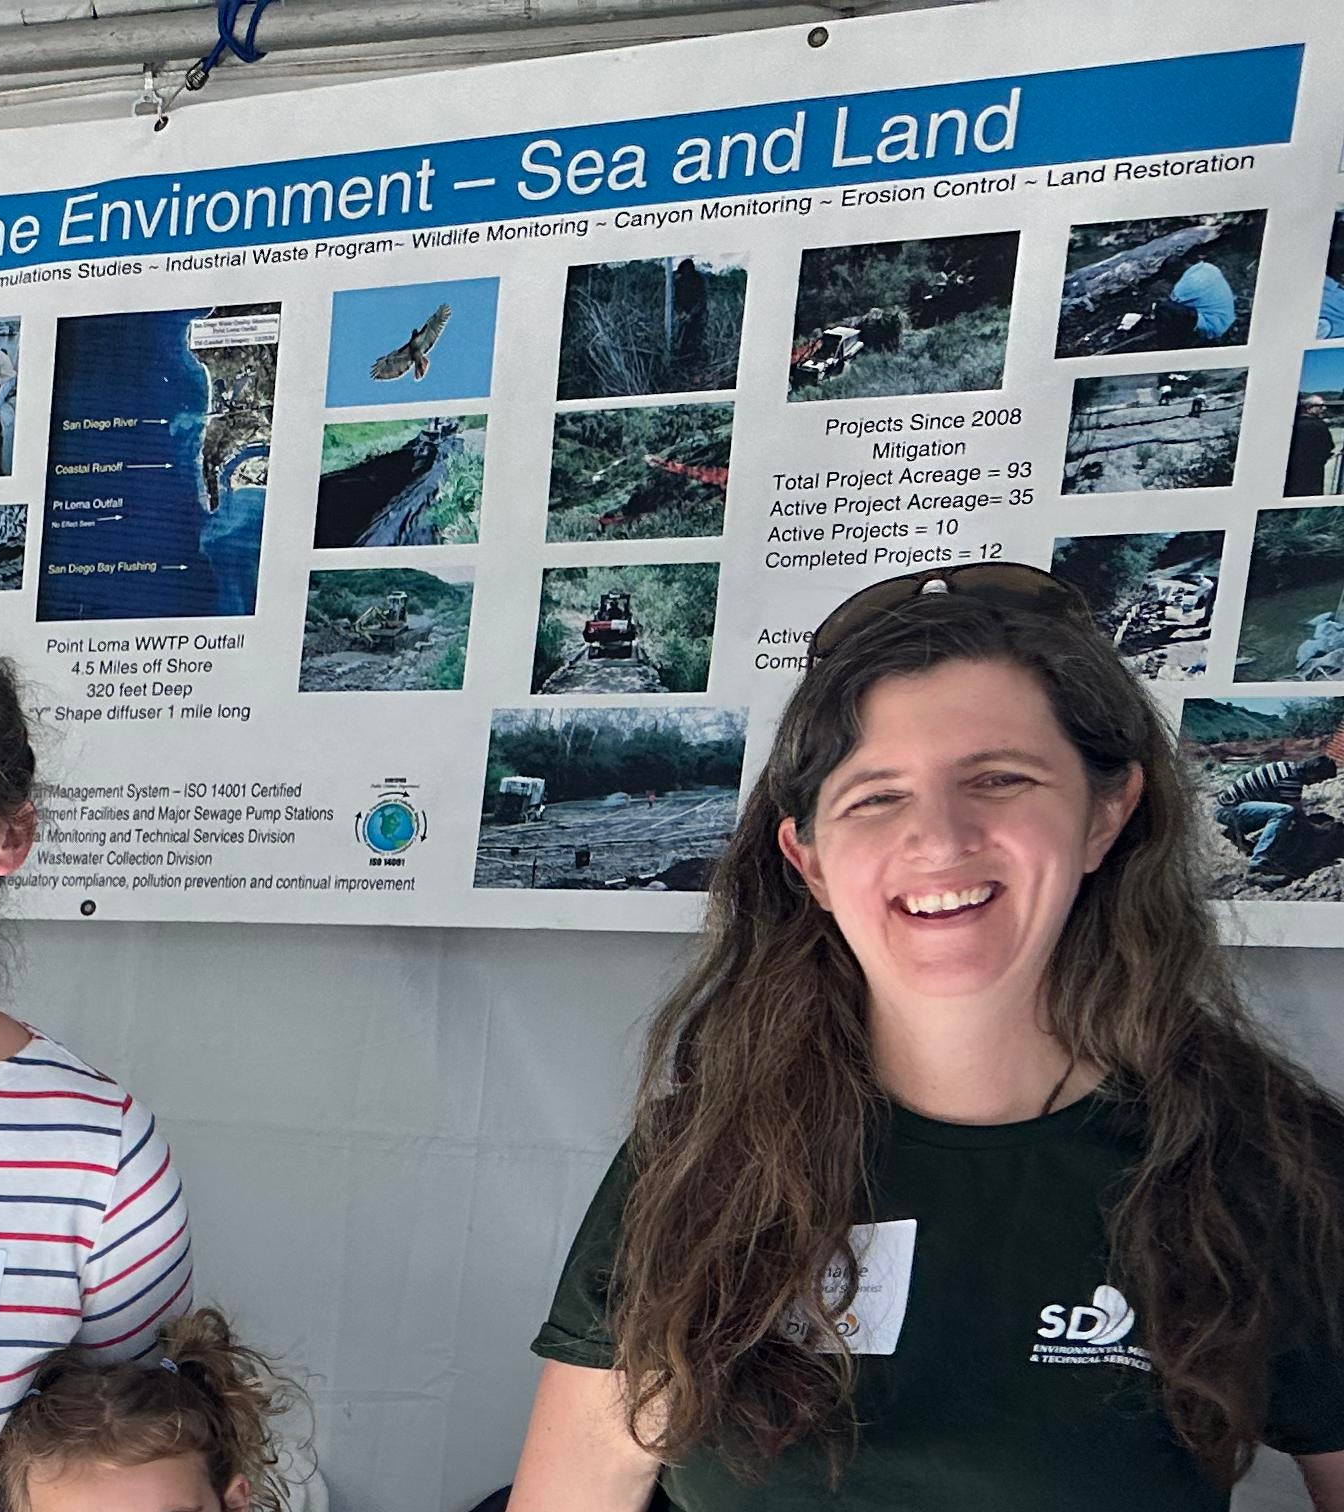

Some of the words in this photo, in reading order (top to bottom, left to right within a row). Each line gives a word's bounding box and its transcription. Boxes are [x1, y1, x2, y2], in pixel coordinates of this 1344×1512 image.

[59, 158, 435, 248] Environment
[518, 139, 646, 201] Sea
[673, 111, 805, 182] and
[832, 88, 1021, 168] Land
[78, 260, 142, 281] Studies
[165, 250, 247, 273] Industrial
[253, 245, 309, 265] Waste
[412, 226, 480, 249] Wildlife
[487, 217, 588, 244] Monitoring
[614, 206, 694, 231] Canyon
[701, 196, 812, 222] Monitoring
[841, 184, 925, 208] Erosion
[933, 174, 1016, 199] Control
[1047, 165, 1105, 188] Land
[1114, 152, 1255, 181] Restoration
[63, 421, 80, 431] San
[84, 419, 111, 431] Diego
[113, 417, 138, 428] River
[825, 416, 903, 437] Projects
[910, 413, 965, 431] Since
[972, 408, 1022, 427] 2008
[873, 441, 966, 461] Mitigation
[55, 464, 90, 475] Coastal
[92, 462, 123, 473] Runoff
[773, 474, 819, 491] Total
[826, 470, 893, 491] Project
[898, 465, 981, 484] Acreage
[1007, 462, 1032, 479] 93
[770, 499, 827, 517] Active
[834, 495, 901, 516] Project
[1009, 488, 1034, 505] 35
[767, 524, 824, 542] Active
[832, 521, 908, 542] Projects
[936, 519, 958, 535] 10
[765, 547, 867, 569] Completed
[874, 545, 952, 565] Projects
[979, 543, 1003, 559] 12
[47, 638, 83, 654] Point
[88, 637, 129, 652] Loma
[135, 636, 189, 651] WWTP
[194, 635, 244, 650] Outfall
[71, 661, 95, 676] 4.5
[99, 659, 138, 674] Miles
[142, 659, 162, 673] off
[167, 658, 213, 673] Shore
[86, 683, 115, 697] 320
[118, 682, 149, 697] feet
[152, 682, 193, 700] Deep
[55, 706, 102, 724] Shape
[107, 705, 162, 720] diffuser
[168, 706, 175, 719] 1
[181, 705, 213, 719] mile
[217, 704, 251, 722] long
[37, 851, 103, 866] Wastewater
[106, 851, 163, 866] Collection
[167, 852, 212, 866] Division
[1037, 1304, 1108, 1340] SD
